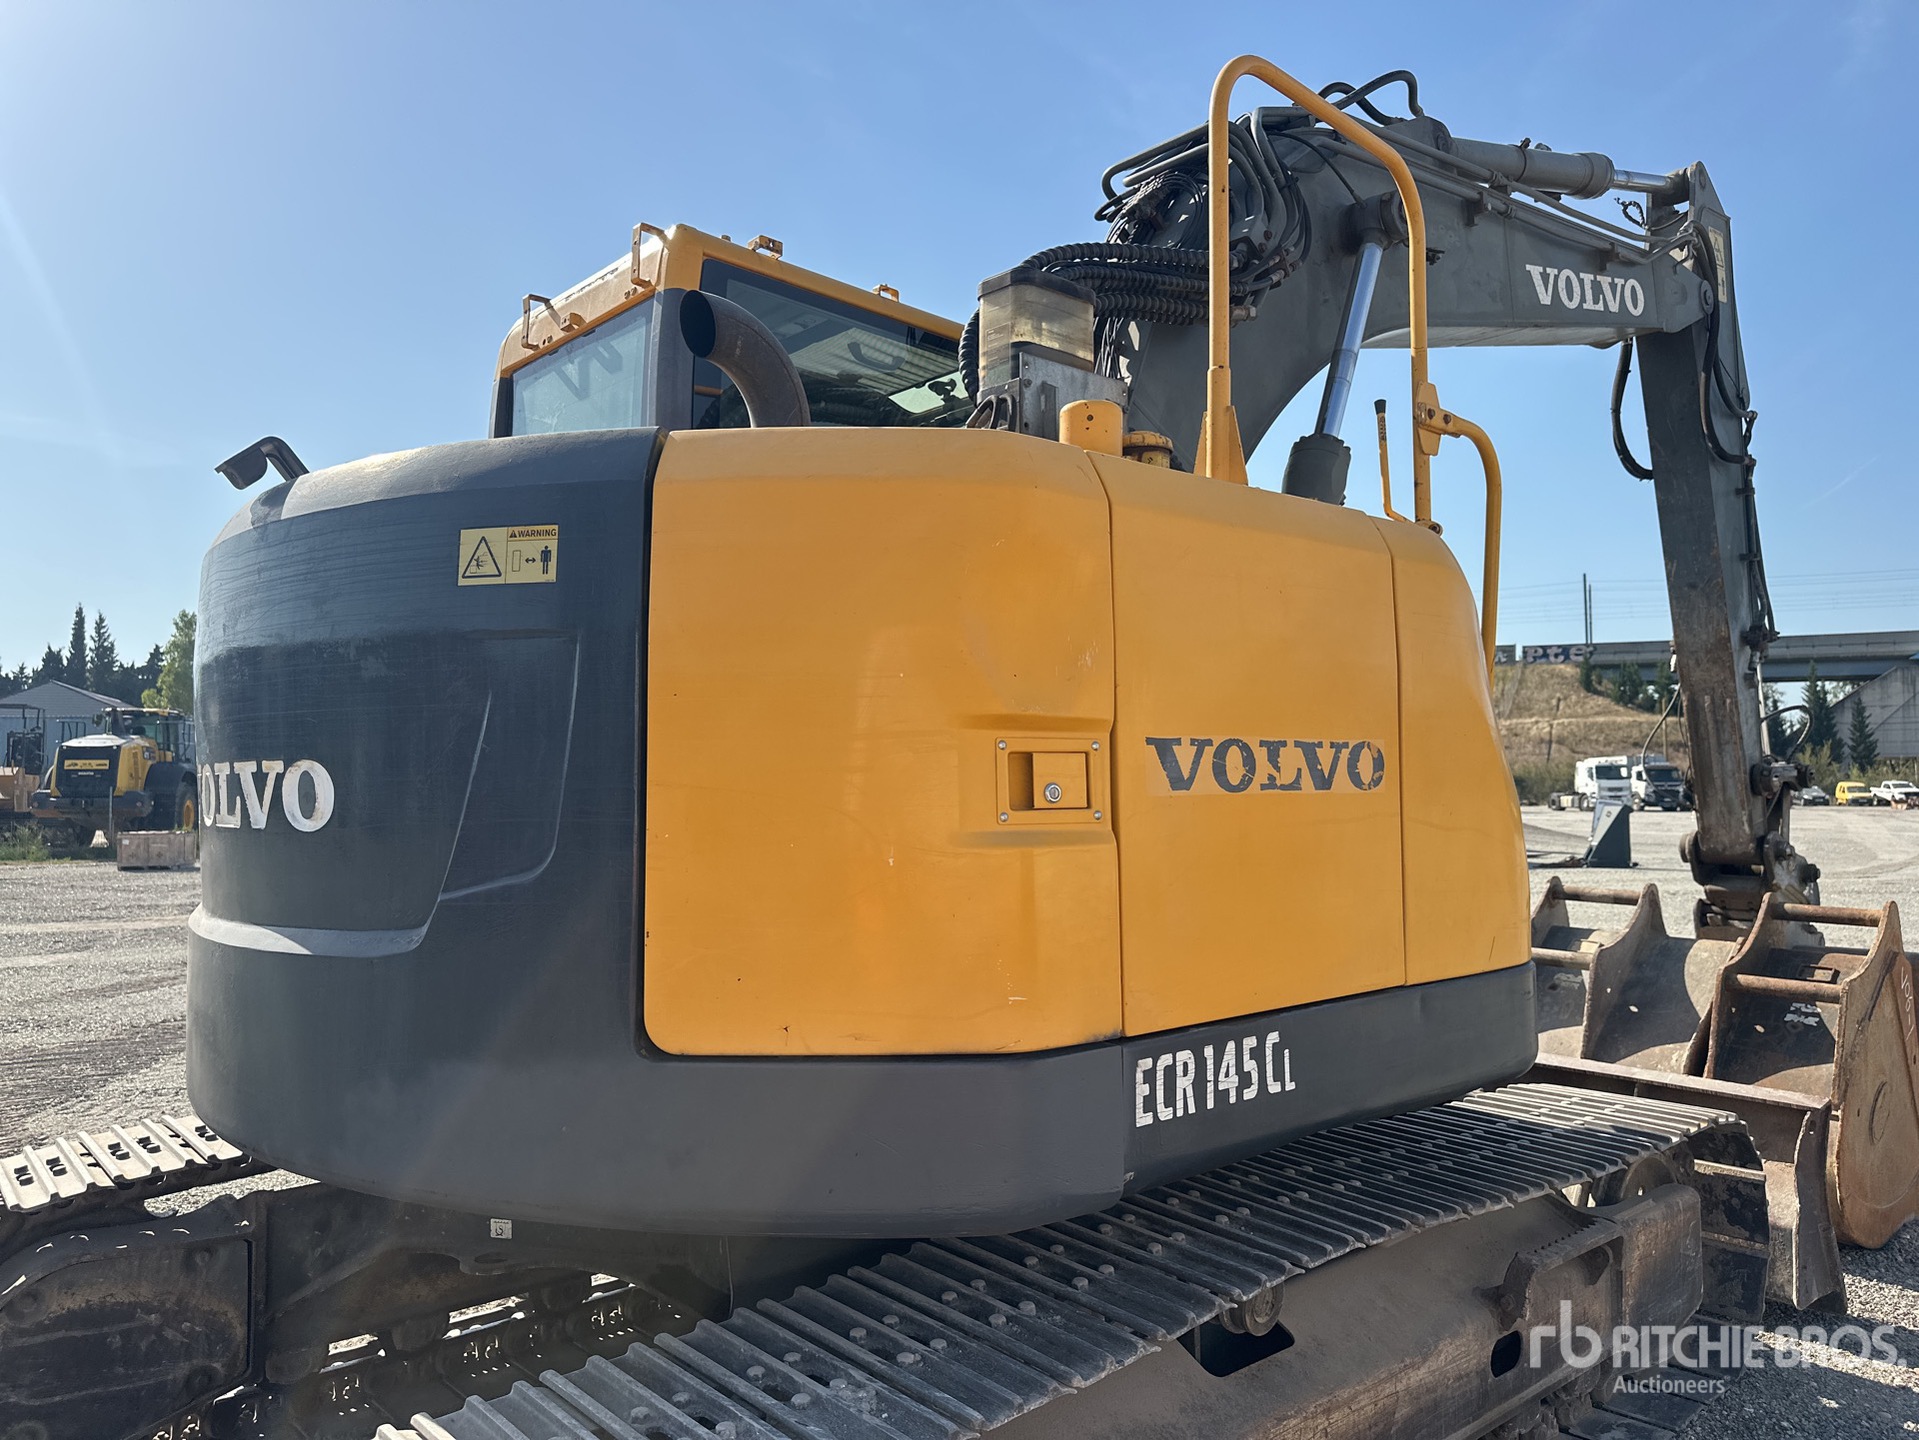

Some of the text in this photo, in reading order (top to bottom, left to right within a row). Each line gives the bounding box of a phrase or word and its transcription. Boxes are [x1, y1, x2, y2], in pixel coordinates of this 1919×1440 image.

[1525, 264, 1645, 317] VOLVO
[517, 528, 557, 538] WARNING
[1145, 736, 1385, 793] VOLVO
[198, 759, 334, 832] OLVO
